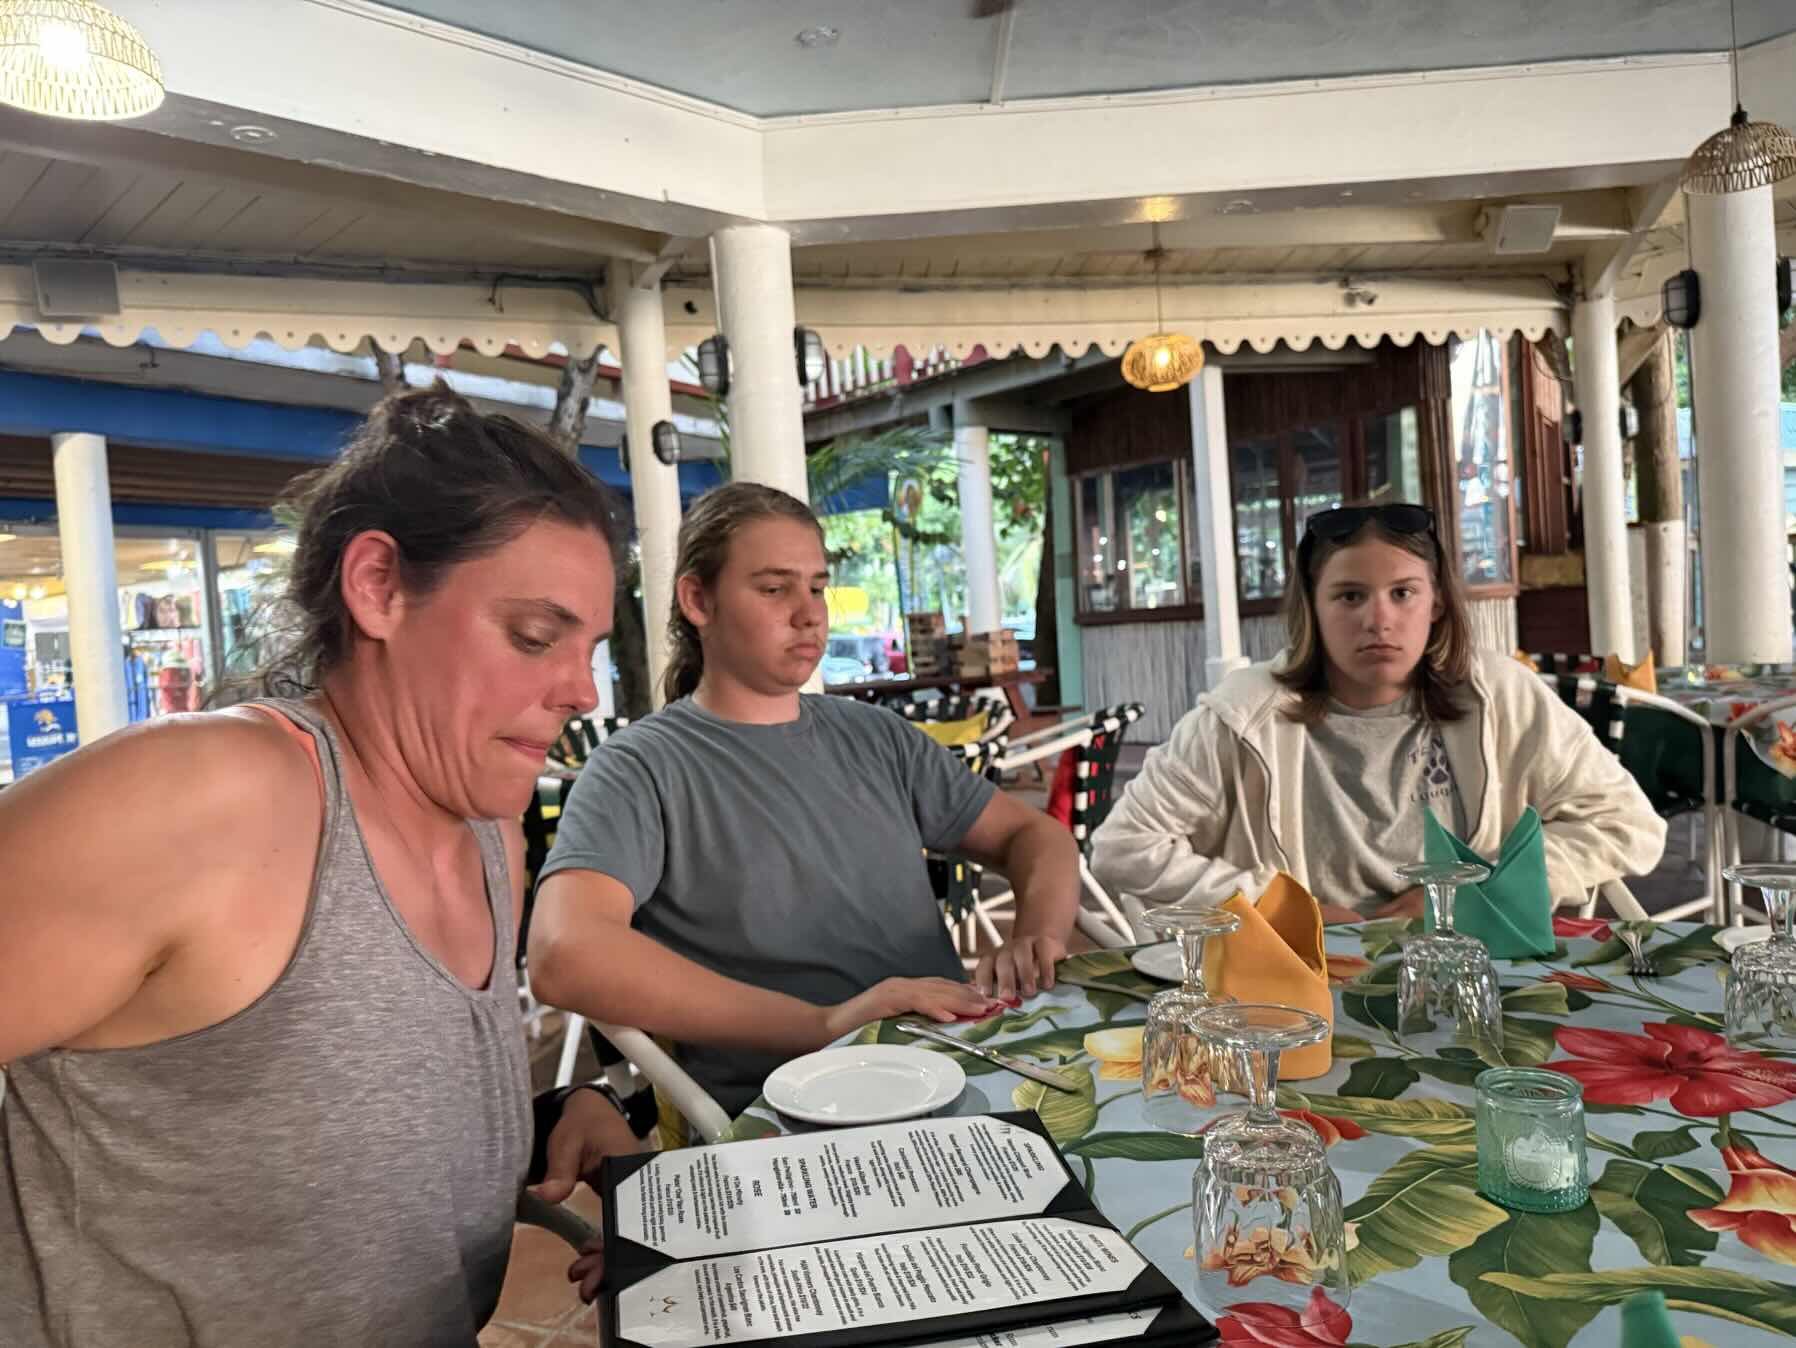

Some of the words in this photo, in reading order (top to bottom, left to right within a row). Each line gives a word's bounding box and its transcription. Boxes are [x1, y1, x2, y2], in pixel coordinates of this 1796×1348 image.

[752, 1179, 761, 1197] ROSE
[797, 1157, 811, 1188] SPARKLING
[806, 1188, 817, 1209] WATER
[963, 1166, 982, 1195] Champagne
[1025, 1255, 1054, 1281] Chardonnay
[807, 1288, 825, 1316] Chardonnay
